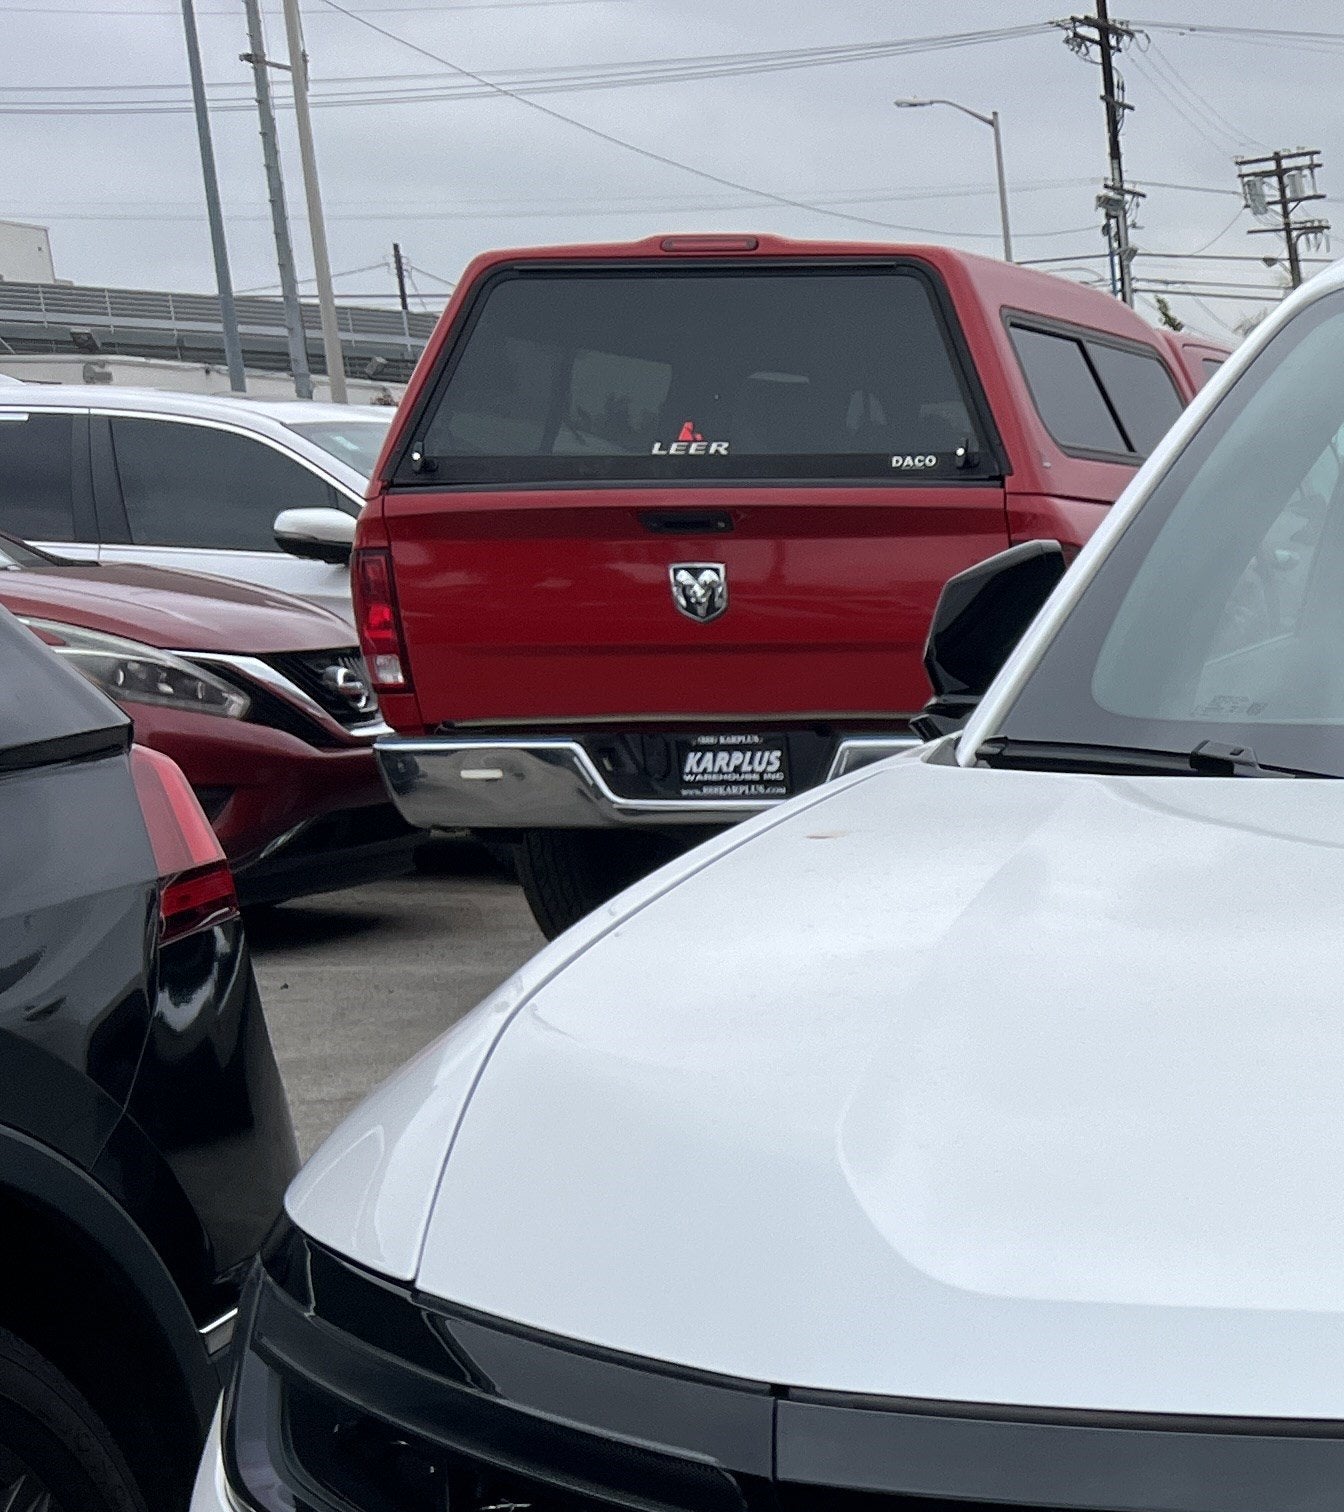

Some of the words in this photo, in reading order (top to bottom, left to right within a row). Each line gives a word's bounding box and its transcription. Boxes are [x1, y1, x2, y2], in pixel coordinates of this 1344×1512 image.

[651, 441, 730, 456] LEER
[891, 455, 937, 468] DACO
[684, 750, 782, 773] KARPLUS
[682, 773, 760, 781] WAREHOUSE
[763, 772, 785, 781] INC
